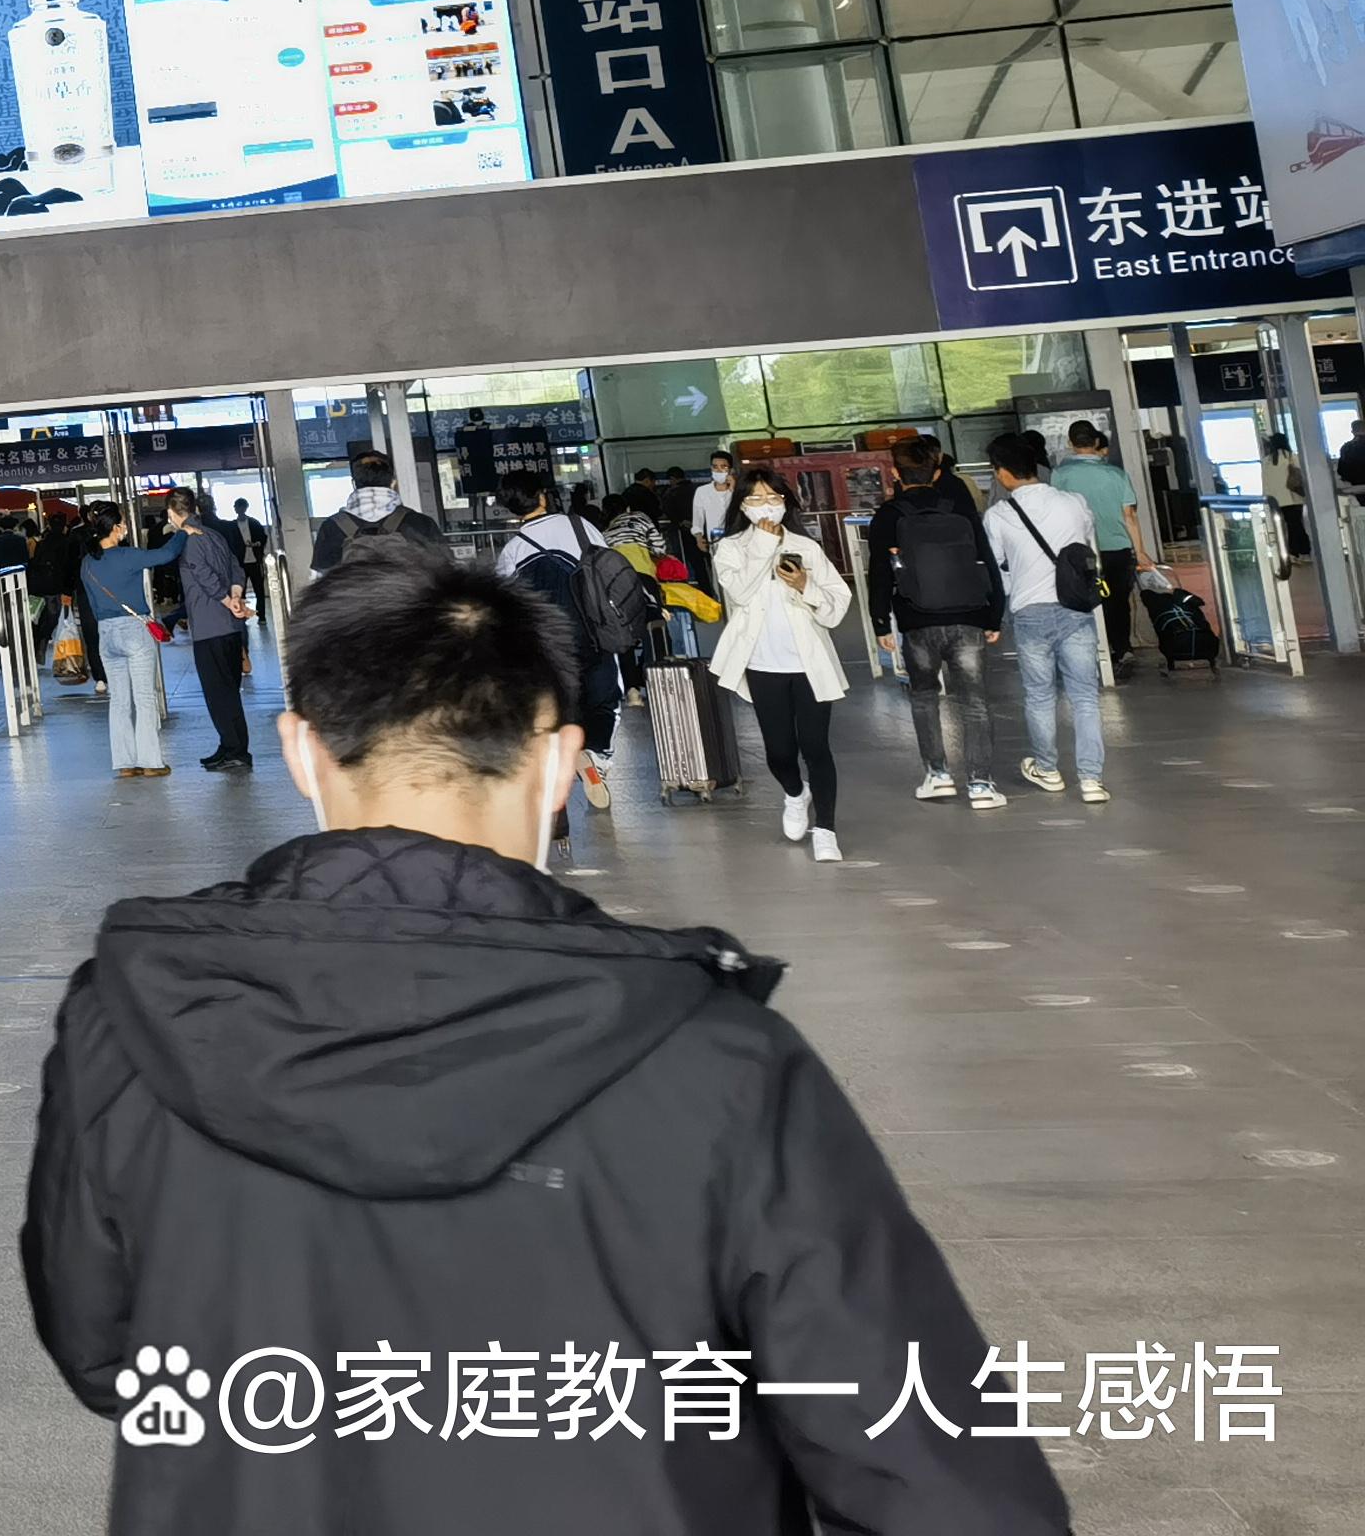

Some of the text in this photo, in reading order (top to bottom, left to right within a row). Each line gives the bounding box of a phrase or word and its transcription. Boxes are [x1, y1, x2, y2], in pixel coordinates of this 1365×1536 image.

[1094, 254, 1162, 280] East
[57, 448, 68, 460] &
[154, 436, 165, 447] 19
[37, 465, 46, 474] &
[53, 462, 98, 474] Security
